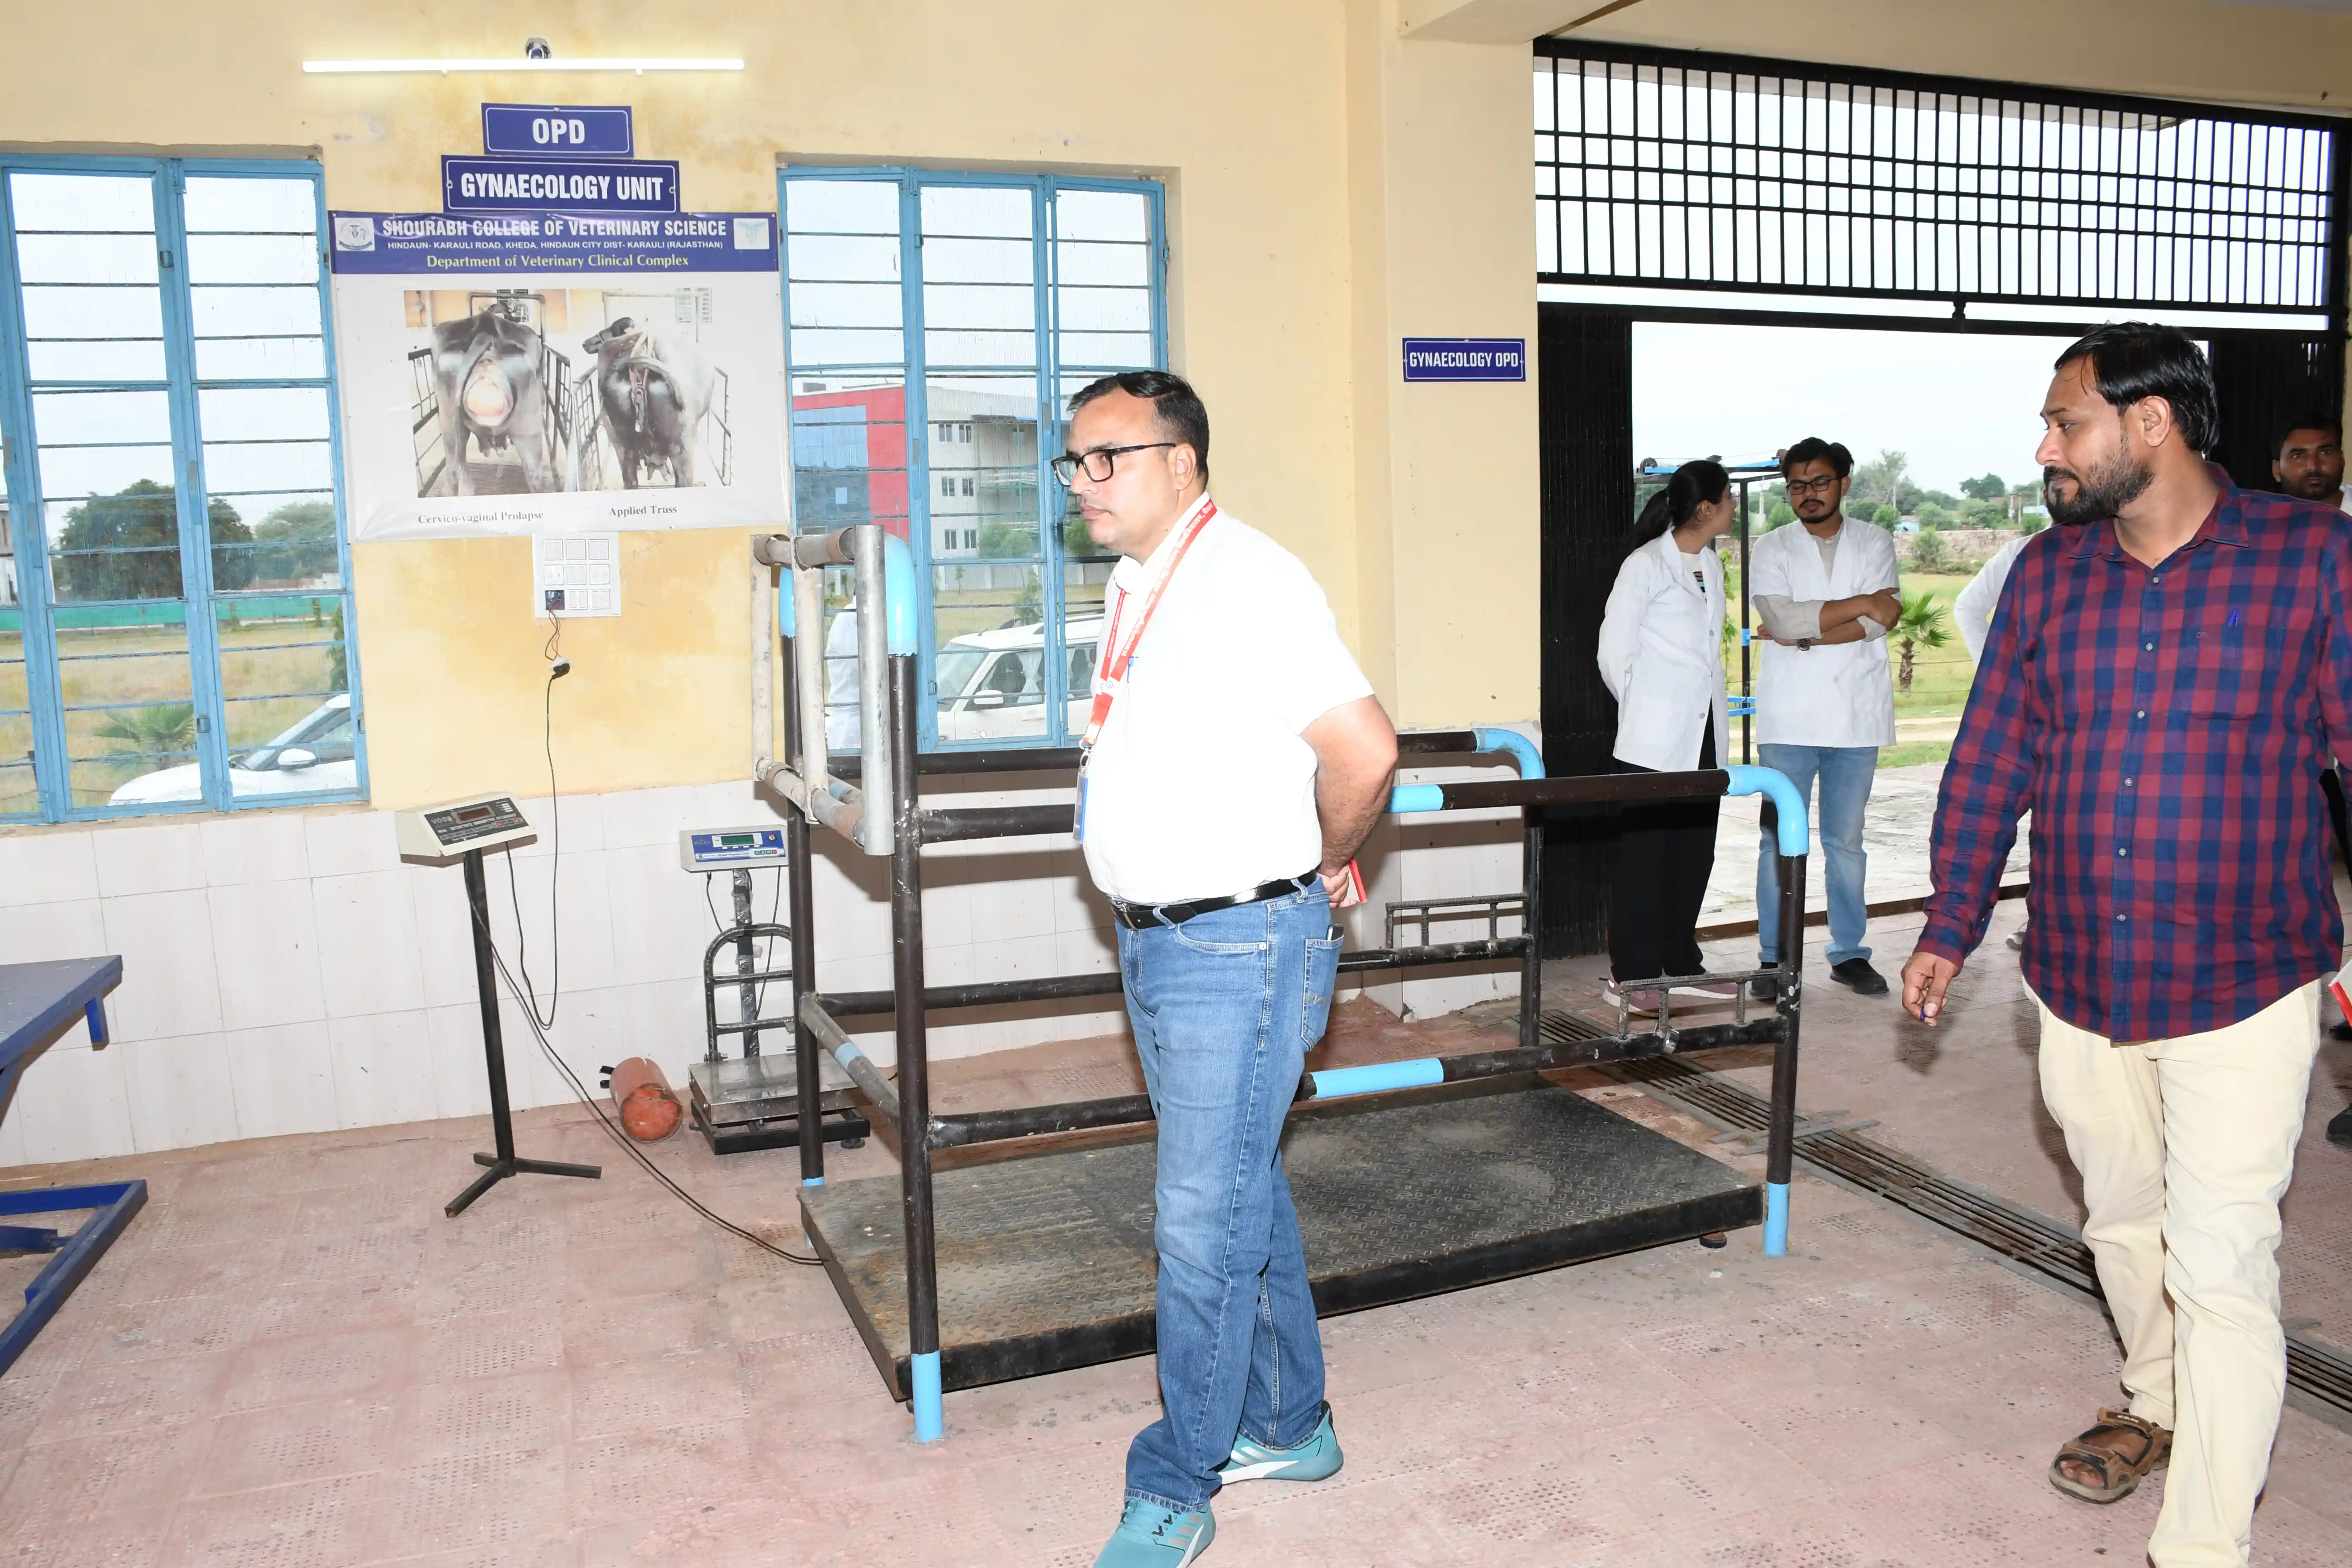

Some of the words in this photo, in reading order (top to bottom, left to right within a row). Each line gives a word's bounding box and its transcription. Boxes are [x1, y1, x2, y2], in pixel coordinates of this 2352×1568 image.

[532, 118, 585, 144] OPD
[461, 172, 610, 199] GYNAECOLOGY
[616, 176, 663, 201] UNIT
[382, 220, 467, 236] SHOURABH
[473, 220, 539, 236] COLLEGE
[544, 220, 564, 236] OF
[568, 220, 659, 236] VETERINARY
[664, 220, 726, 236] SCIENCE
[475, 242, 504, 250] ROAD,
[505, 242, 539, 250] KHEDA,
[667, 241, 723, 250] (RAJASTHAN)
[427, 255, 501, 269] Department
[504, 254, 517, 267] of
[520, 254, 584, 268] Veterinary
[588, 254, 633, 266] Clinical
[637, 254, 689, 268] Complex
[1409, 352, 1492, 368] GYNAECOLOGY
[1495, 352, 1518, 367] OPD
[418, 512, 498, 524] Cervico-vaginal
[501, 511, 544, 521] Prolapse
[609, 506, 647, 518] Applied
[649, 505, 678, 514] Truss
